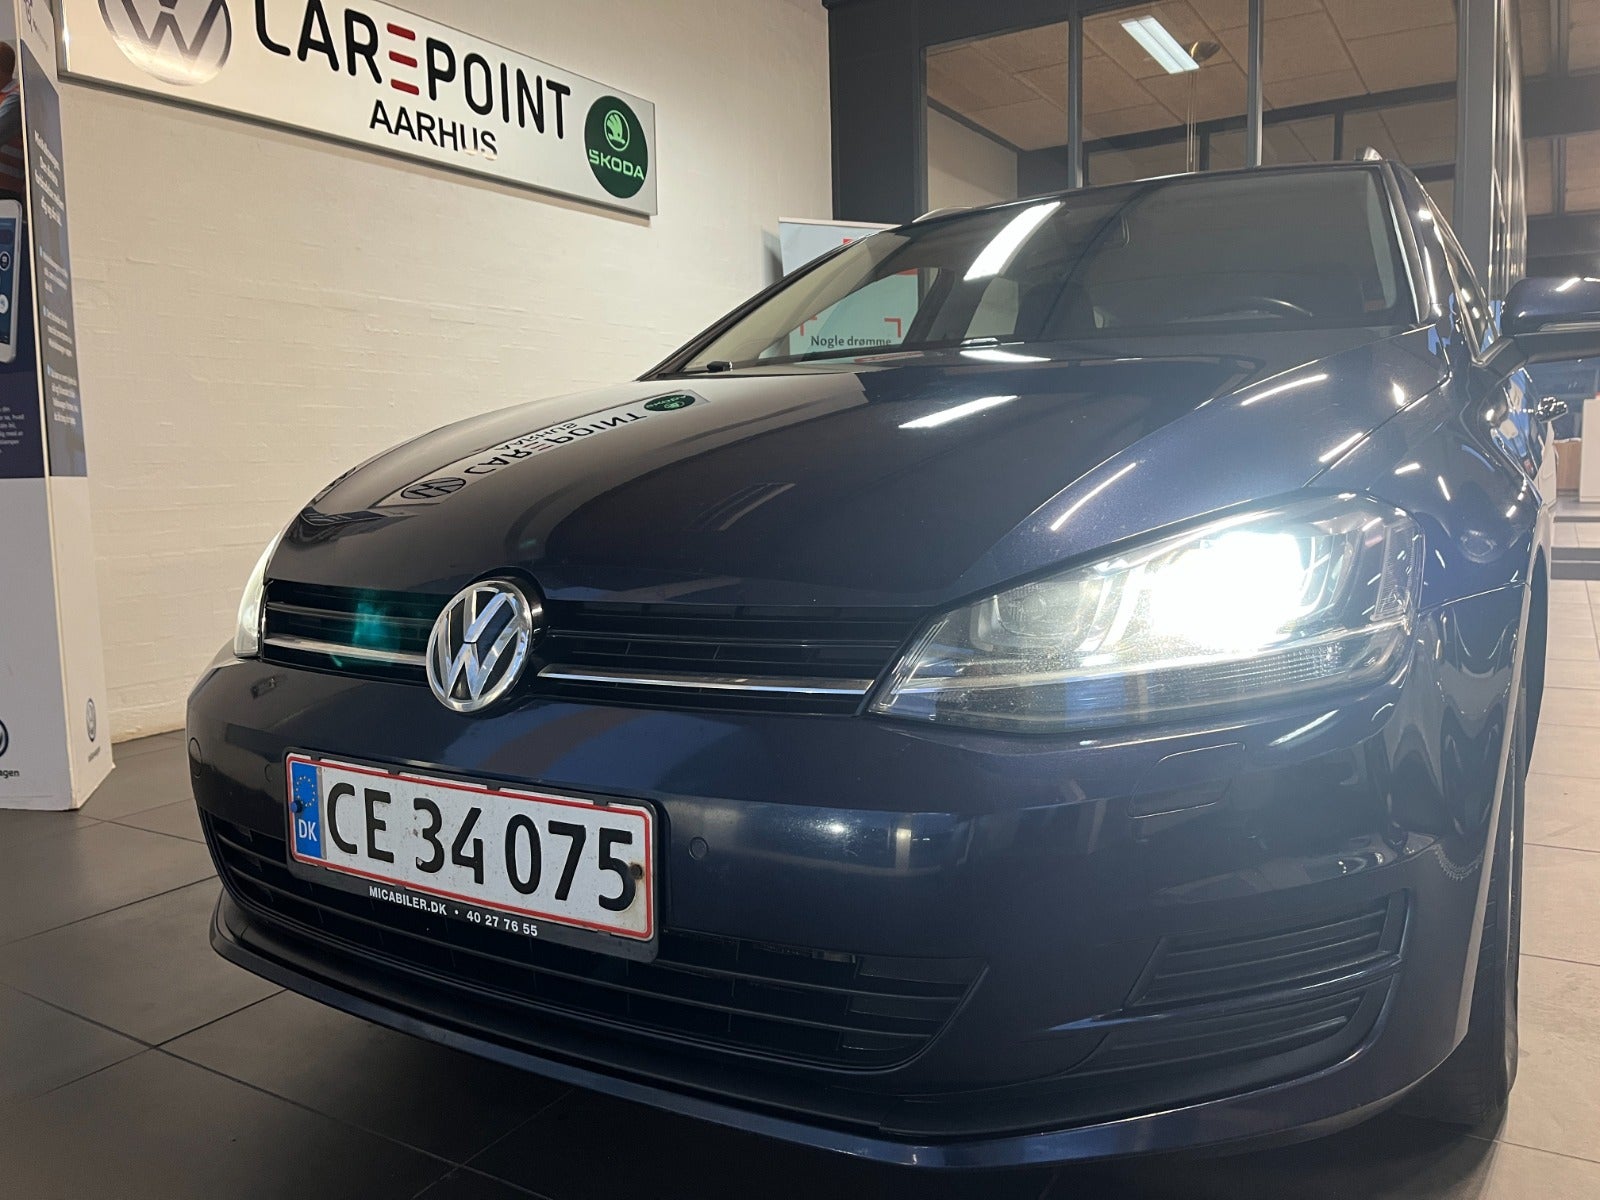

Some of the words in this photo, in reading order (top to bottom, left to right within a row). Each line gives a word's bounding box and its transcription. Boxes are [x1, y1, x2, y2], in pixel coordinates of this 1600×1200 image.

[254, 0, 571, 140] CAREPOINT
[369, 99, 498, 160] AARHUS
[810, 335, 845, 348] Nogle
[847, 336, 892, 346] drømme
[299, 818, 318, 844] DK
[327, 782, 395, 864] CE
[412, 797, 485, 885] 34
[504, 813, 638, 912] 075
[369, 886, 447, 916] MICABILER.DK
[466, 911, 482, 924] 40
[485, 914, 501, 928] 27
[503, 918, 520, 933] 76
[522, 922, 538, 937] 55
